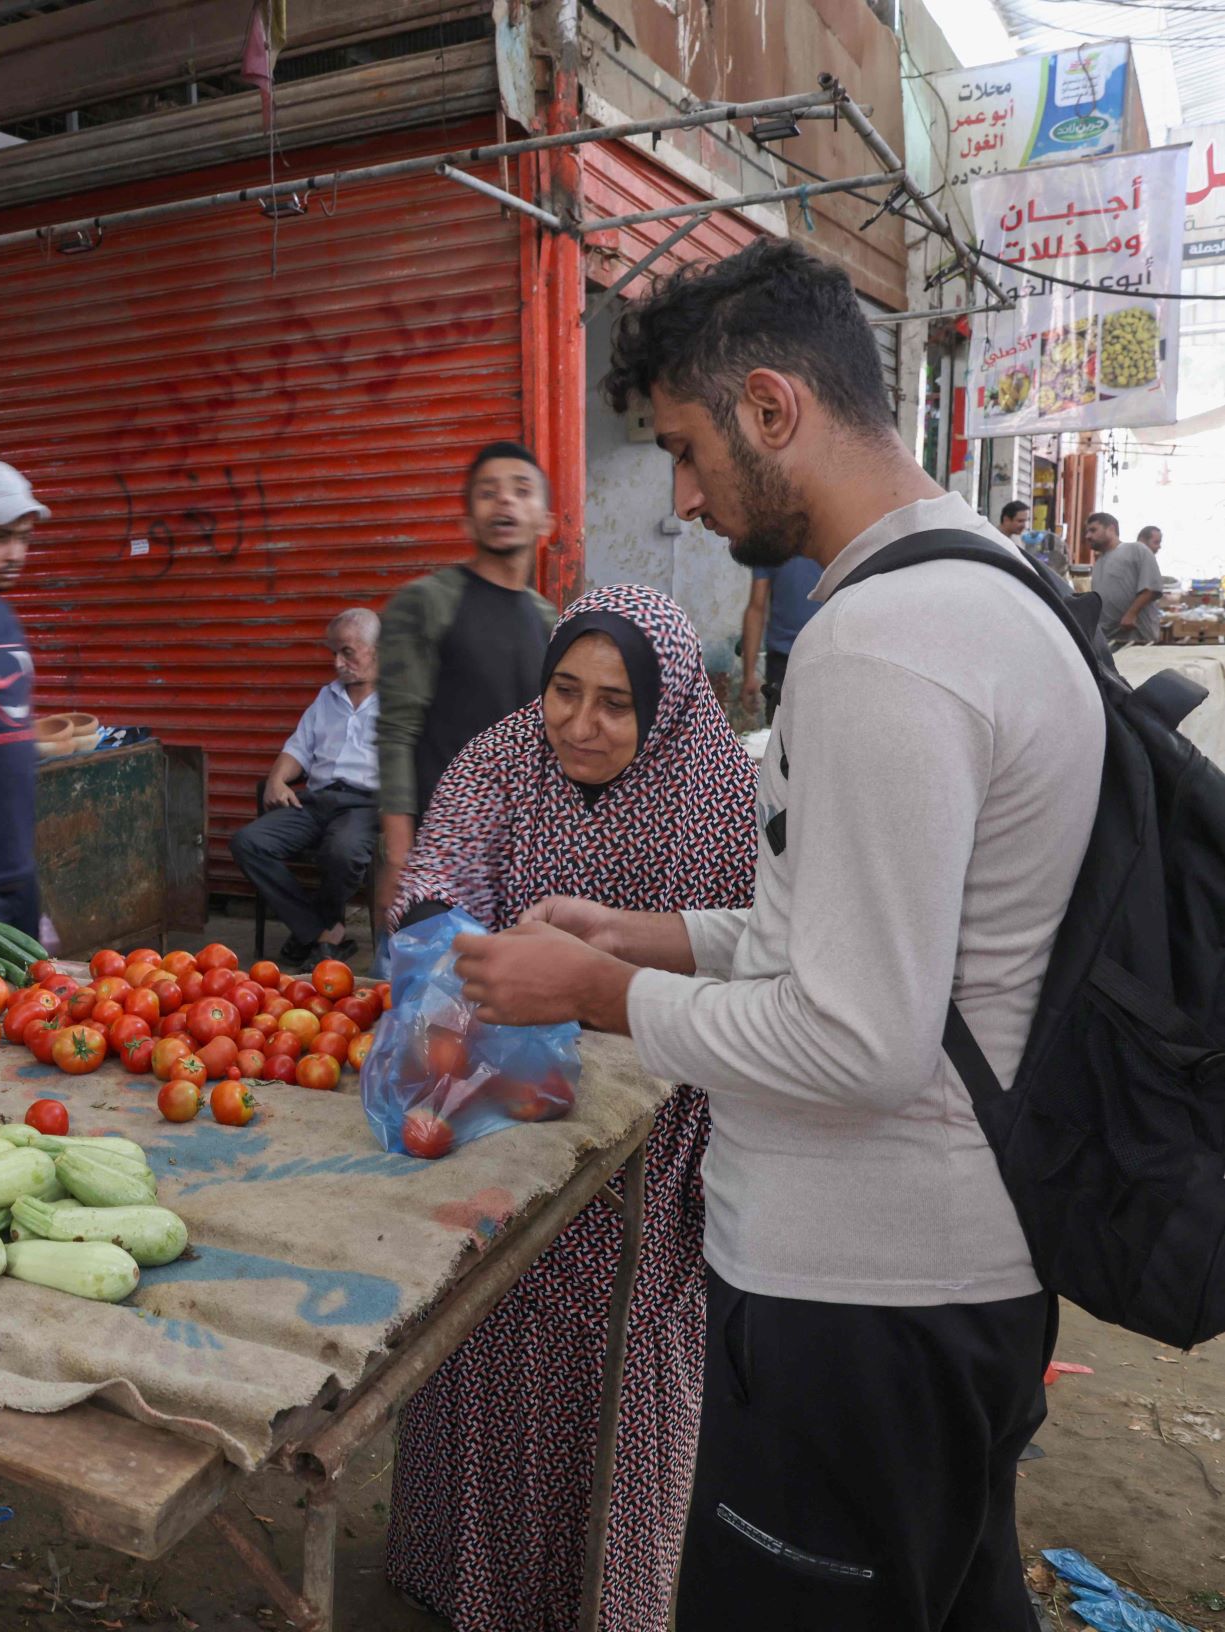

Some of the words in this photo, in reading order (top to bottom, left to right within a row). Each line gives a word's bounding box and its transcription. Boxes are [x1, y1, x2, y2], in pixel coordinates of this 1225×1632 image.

[958, 81, 1012, 102] محلات
[951, 111, 987, 133] عمر
[991, 99, 1015, 128] أبو
[960, 133, 1004, 159] الغول
[1000, 176, 1143, 232] أجبان
[999, 233, 1142, 264] ومخللات
[1116, 256, 1154, 293] أبو
[998, 277, 1053, 301] الغو
